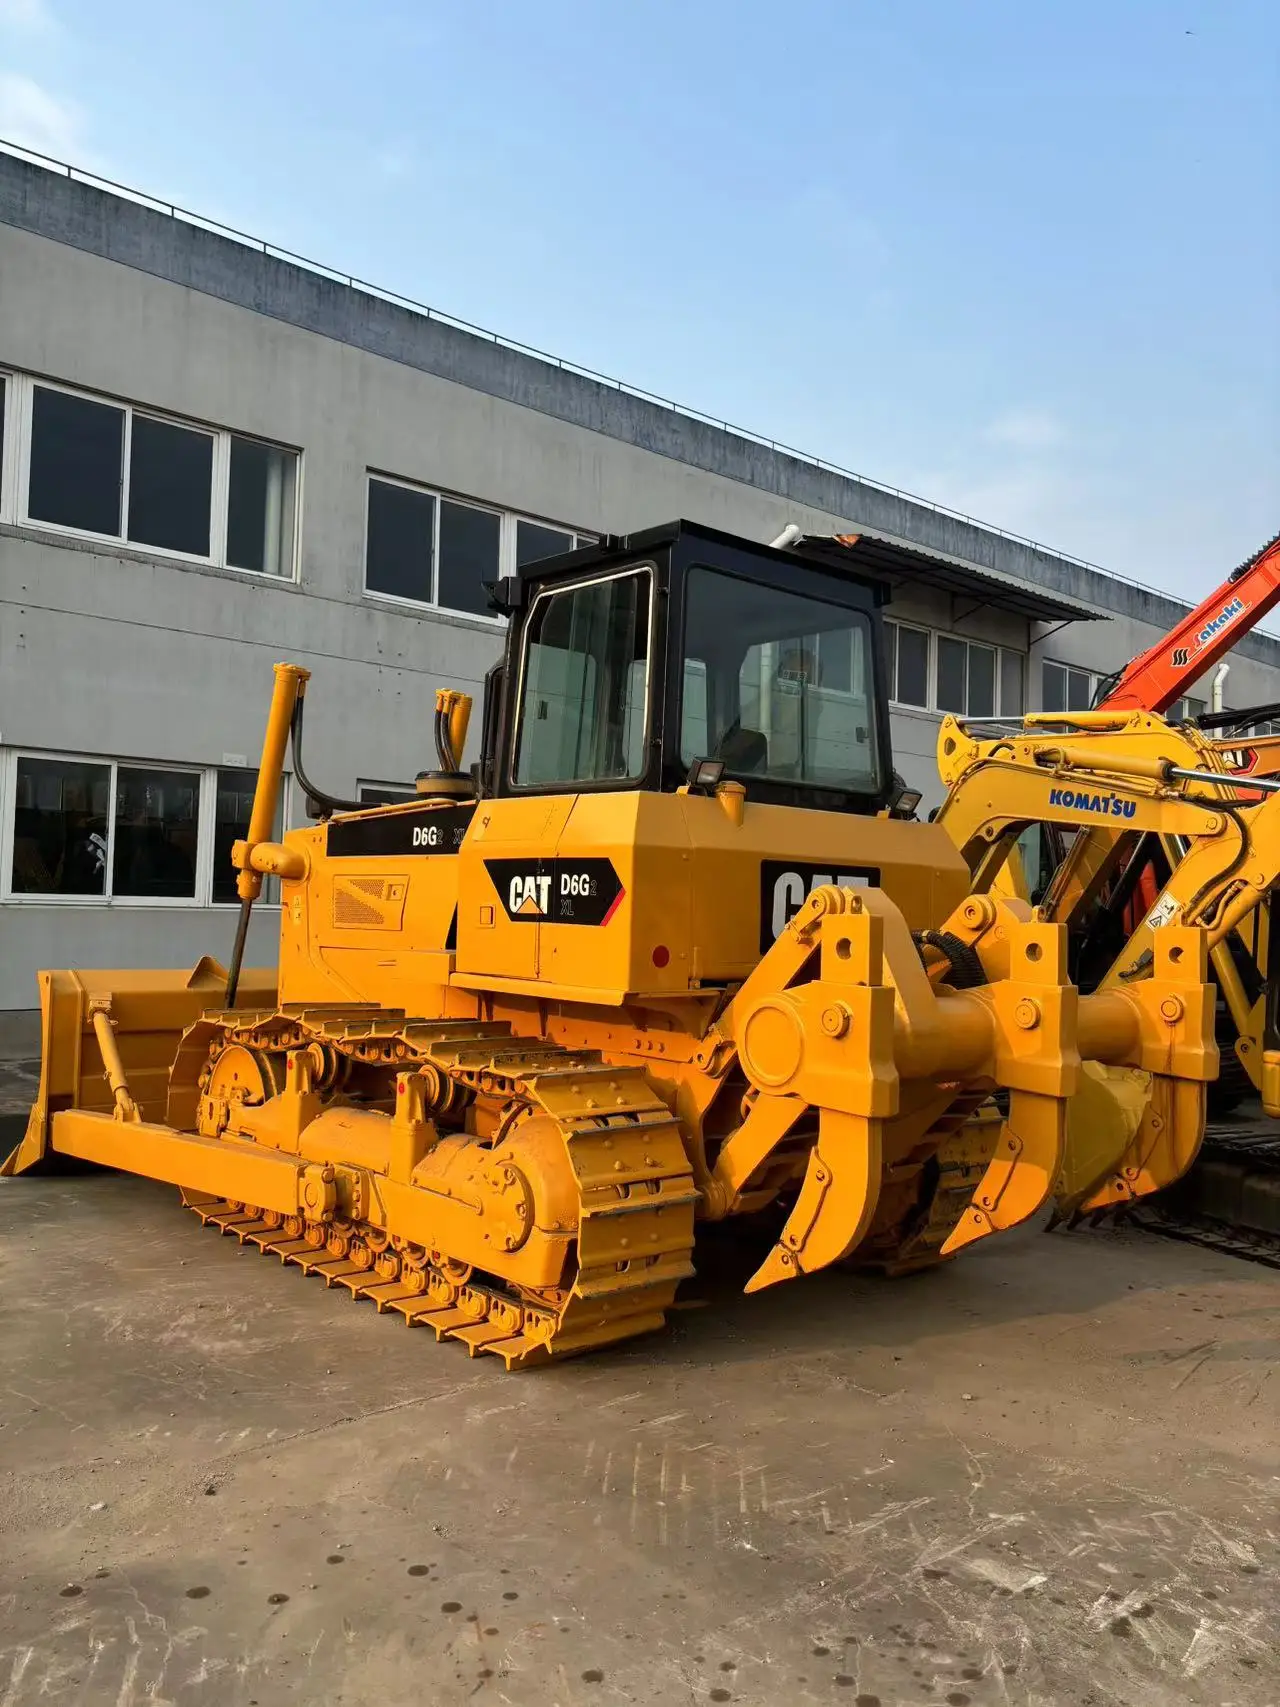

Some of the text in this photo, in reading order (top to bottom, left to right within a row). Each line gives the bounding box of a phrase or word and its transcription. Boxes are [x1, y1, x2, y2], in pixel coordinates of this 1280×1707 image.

[1049, 788, 1137, 818] KOMATSU
[509, 875, 552, 914] CAT
[560, 898, 574, 916] XL
